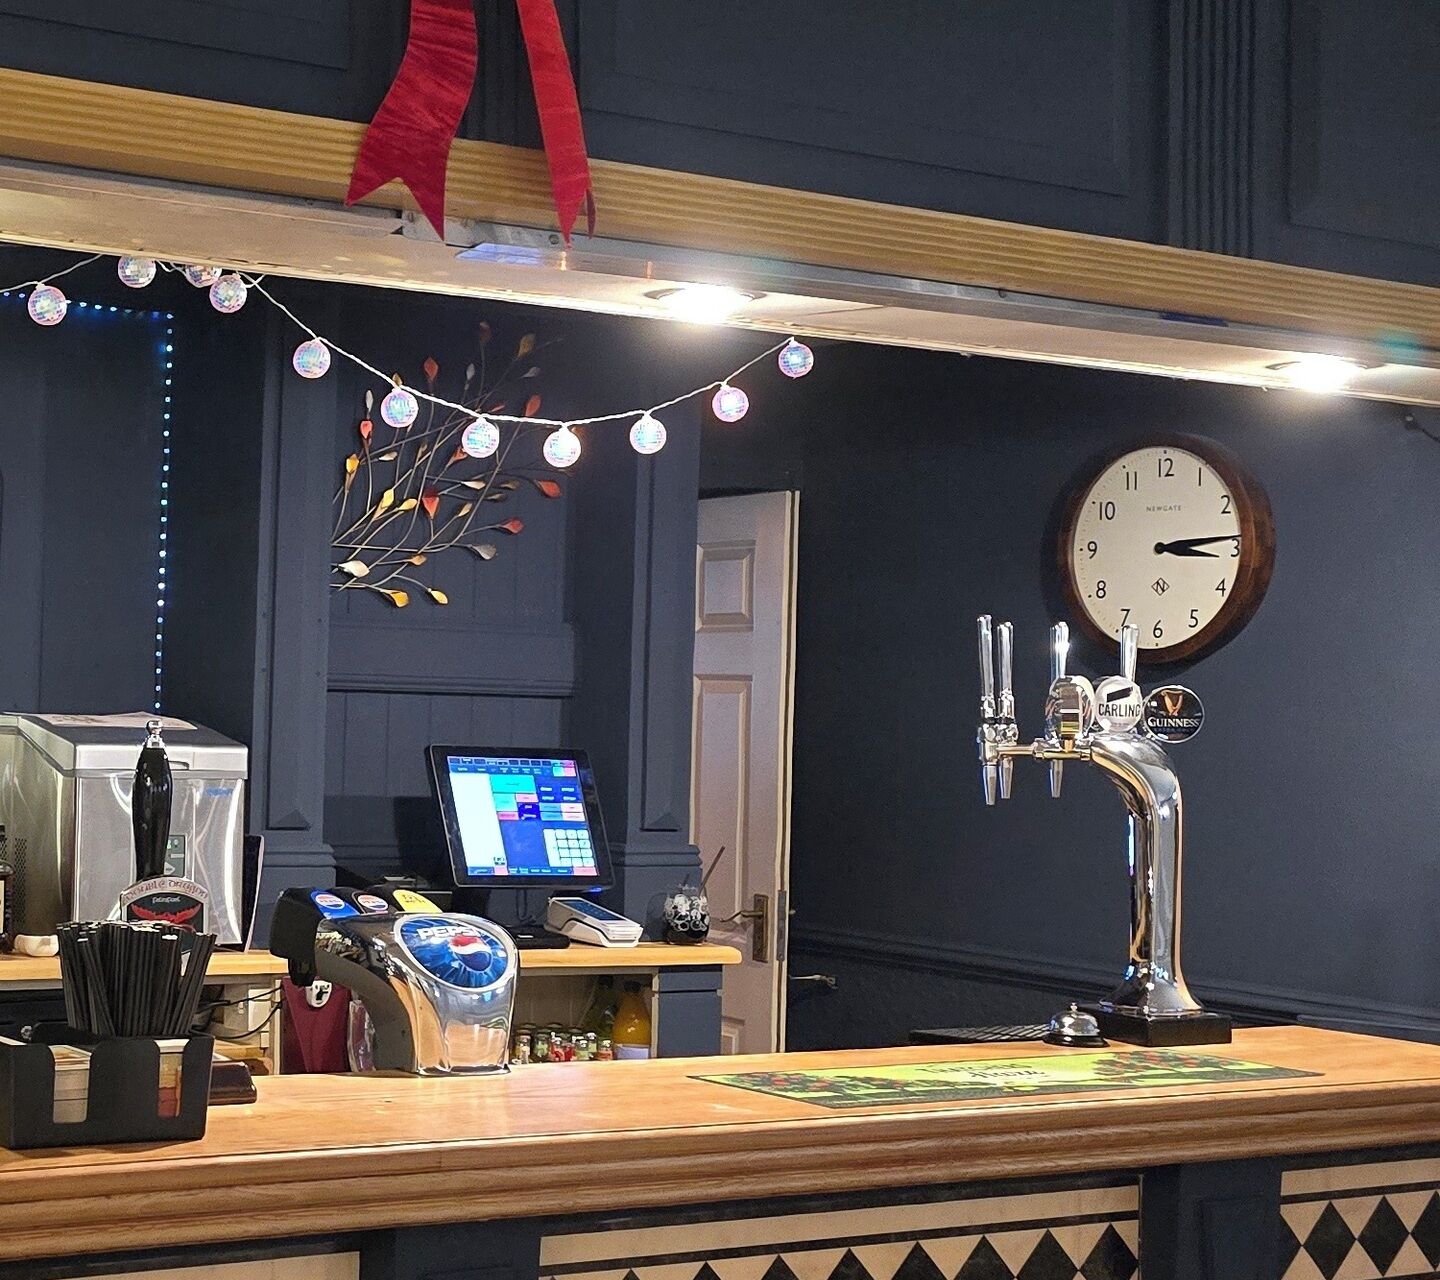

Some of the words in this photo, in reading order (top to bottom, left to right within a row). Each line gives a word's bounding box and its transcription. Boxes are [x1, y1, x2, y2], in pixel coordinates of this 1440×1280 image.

[1157, 457, 1175, 479] 12
[1197, 466, 1202, 487] 1
[1125, 470, 1138, 491] 11
[1098, 501, 1116, 521] 10
[1145, 504, 1183, 513] NEWGATE
[1220, 494, 1232, 515] 2
[1086, 540, 1098, 559] 9
[1229, 539, 1241, 558] 3
[1095, 580, 1107, 599] 8
[1214, 577, 1227, 597] 4
[1120, 608, 1131, 627] 7
[1187, 608, 1200, 629] 5
[1152, 620, 1164, 639] 6
[1097, 703, 1142, 718] CARLING
[1147, 716, 1200, 728] GUINNESS
